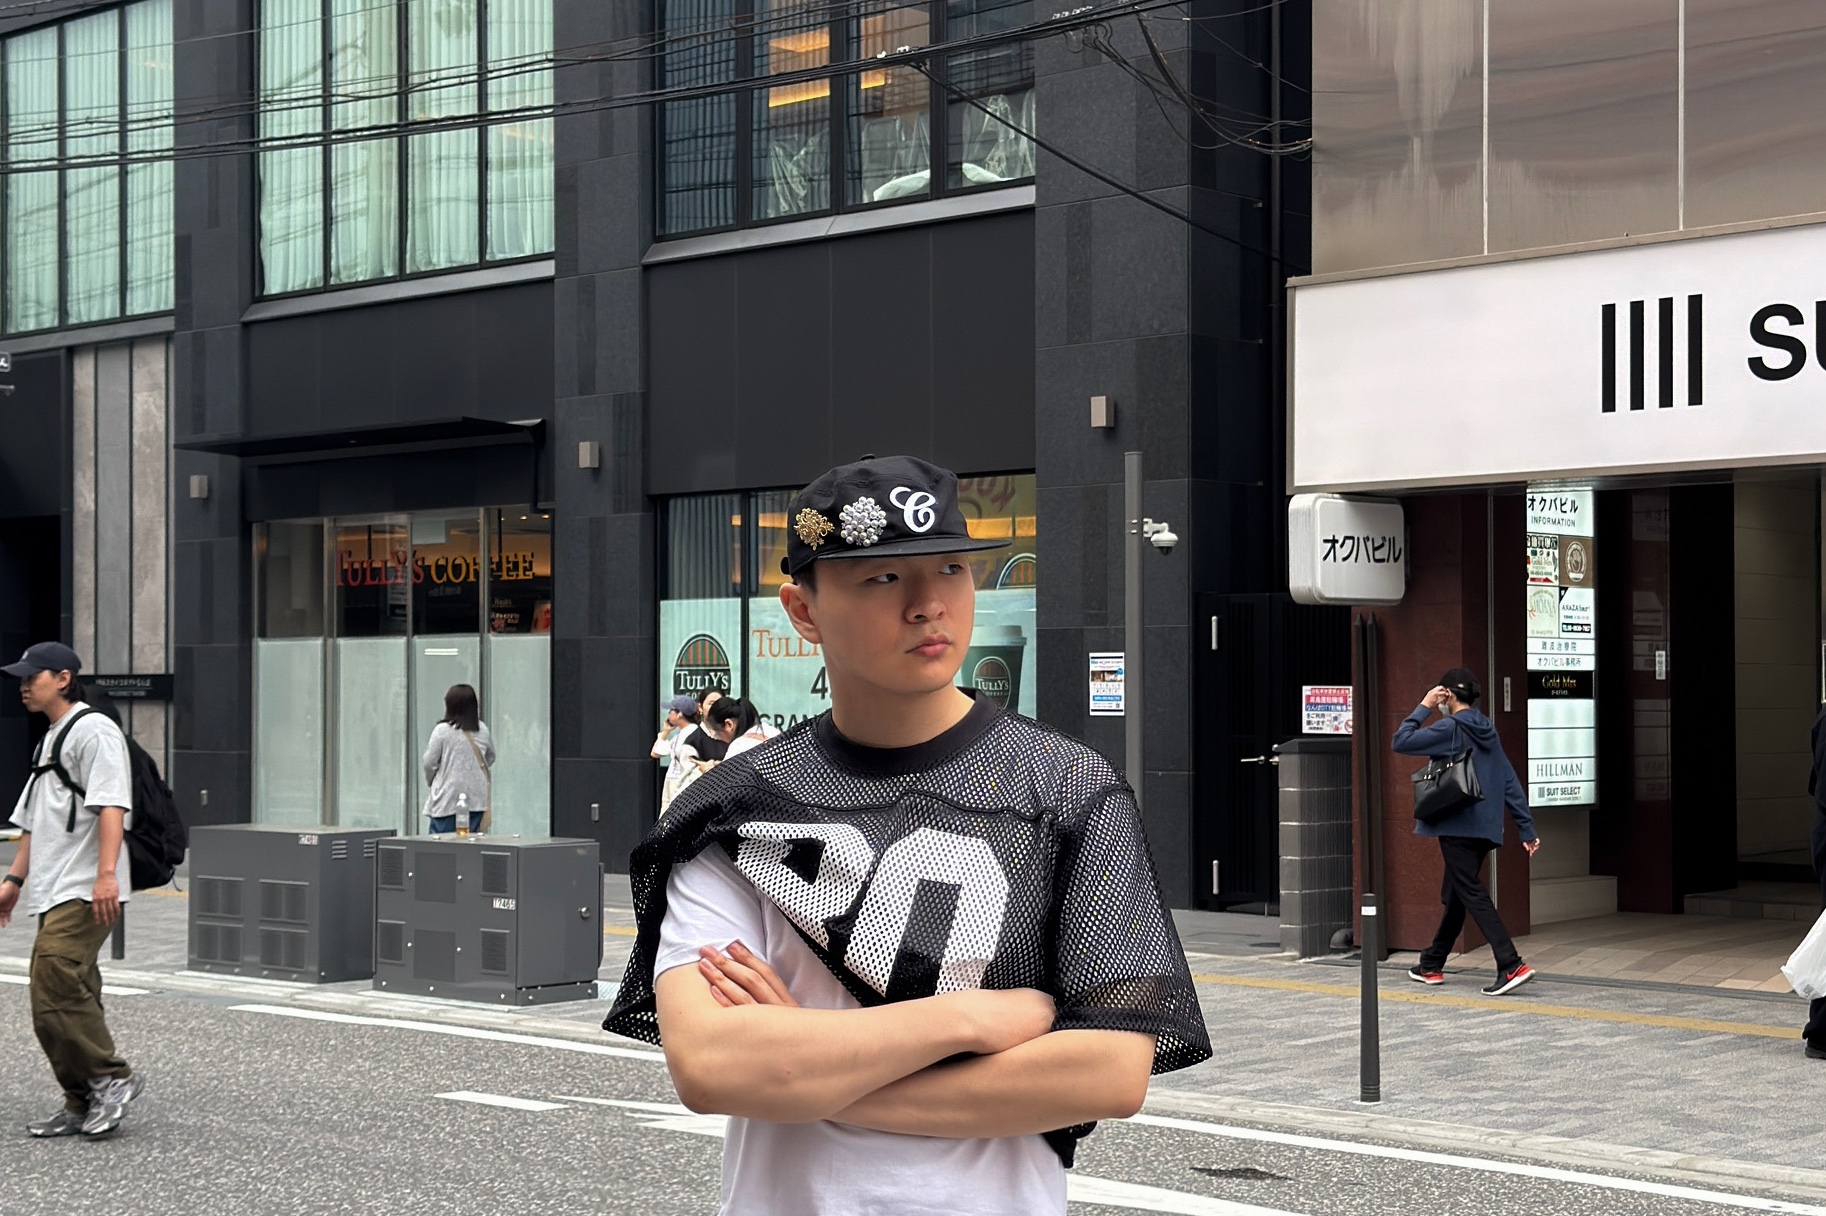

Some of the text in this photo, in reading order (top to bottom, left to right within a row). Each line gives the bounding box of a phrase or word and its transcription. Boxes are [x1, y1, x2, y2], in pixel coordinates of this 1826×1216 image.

[1748, 300, 1826, 381] S
[1528, 495, 1578, 513] オクバビル
[1531, 516, 1576, 527] INFORMATION
[1322, 534, 1402, 563] オクバビル
[1536, 762, 1583, 777] HILLMAN
[1546, 786, 1582, 796] SUIT SELECT
